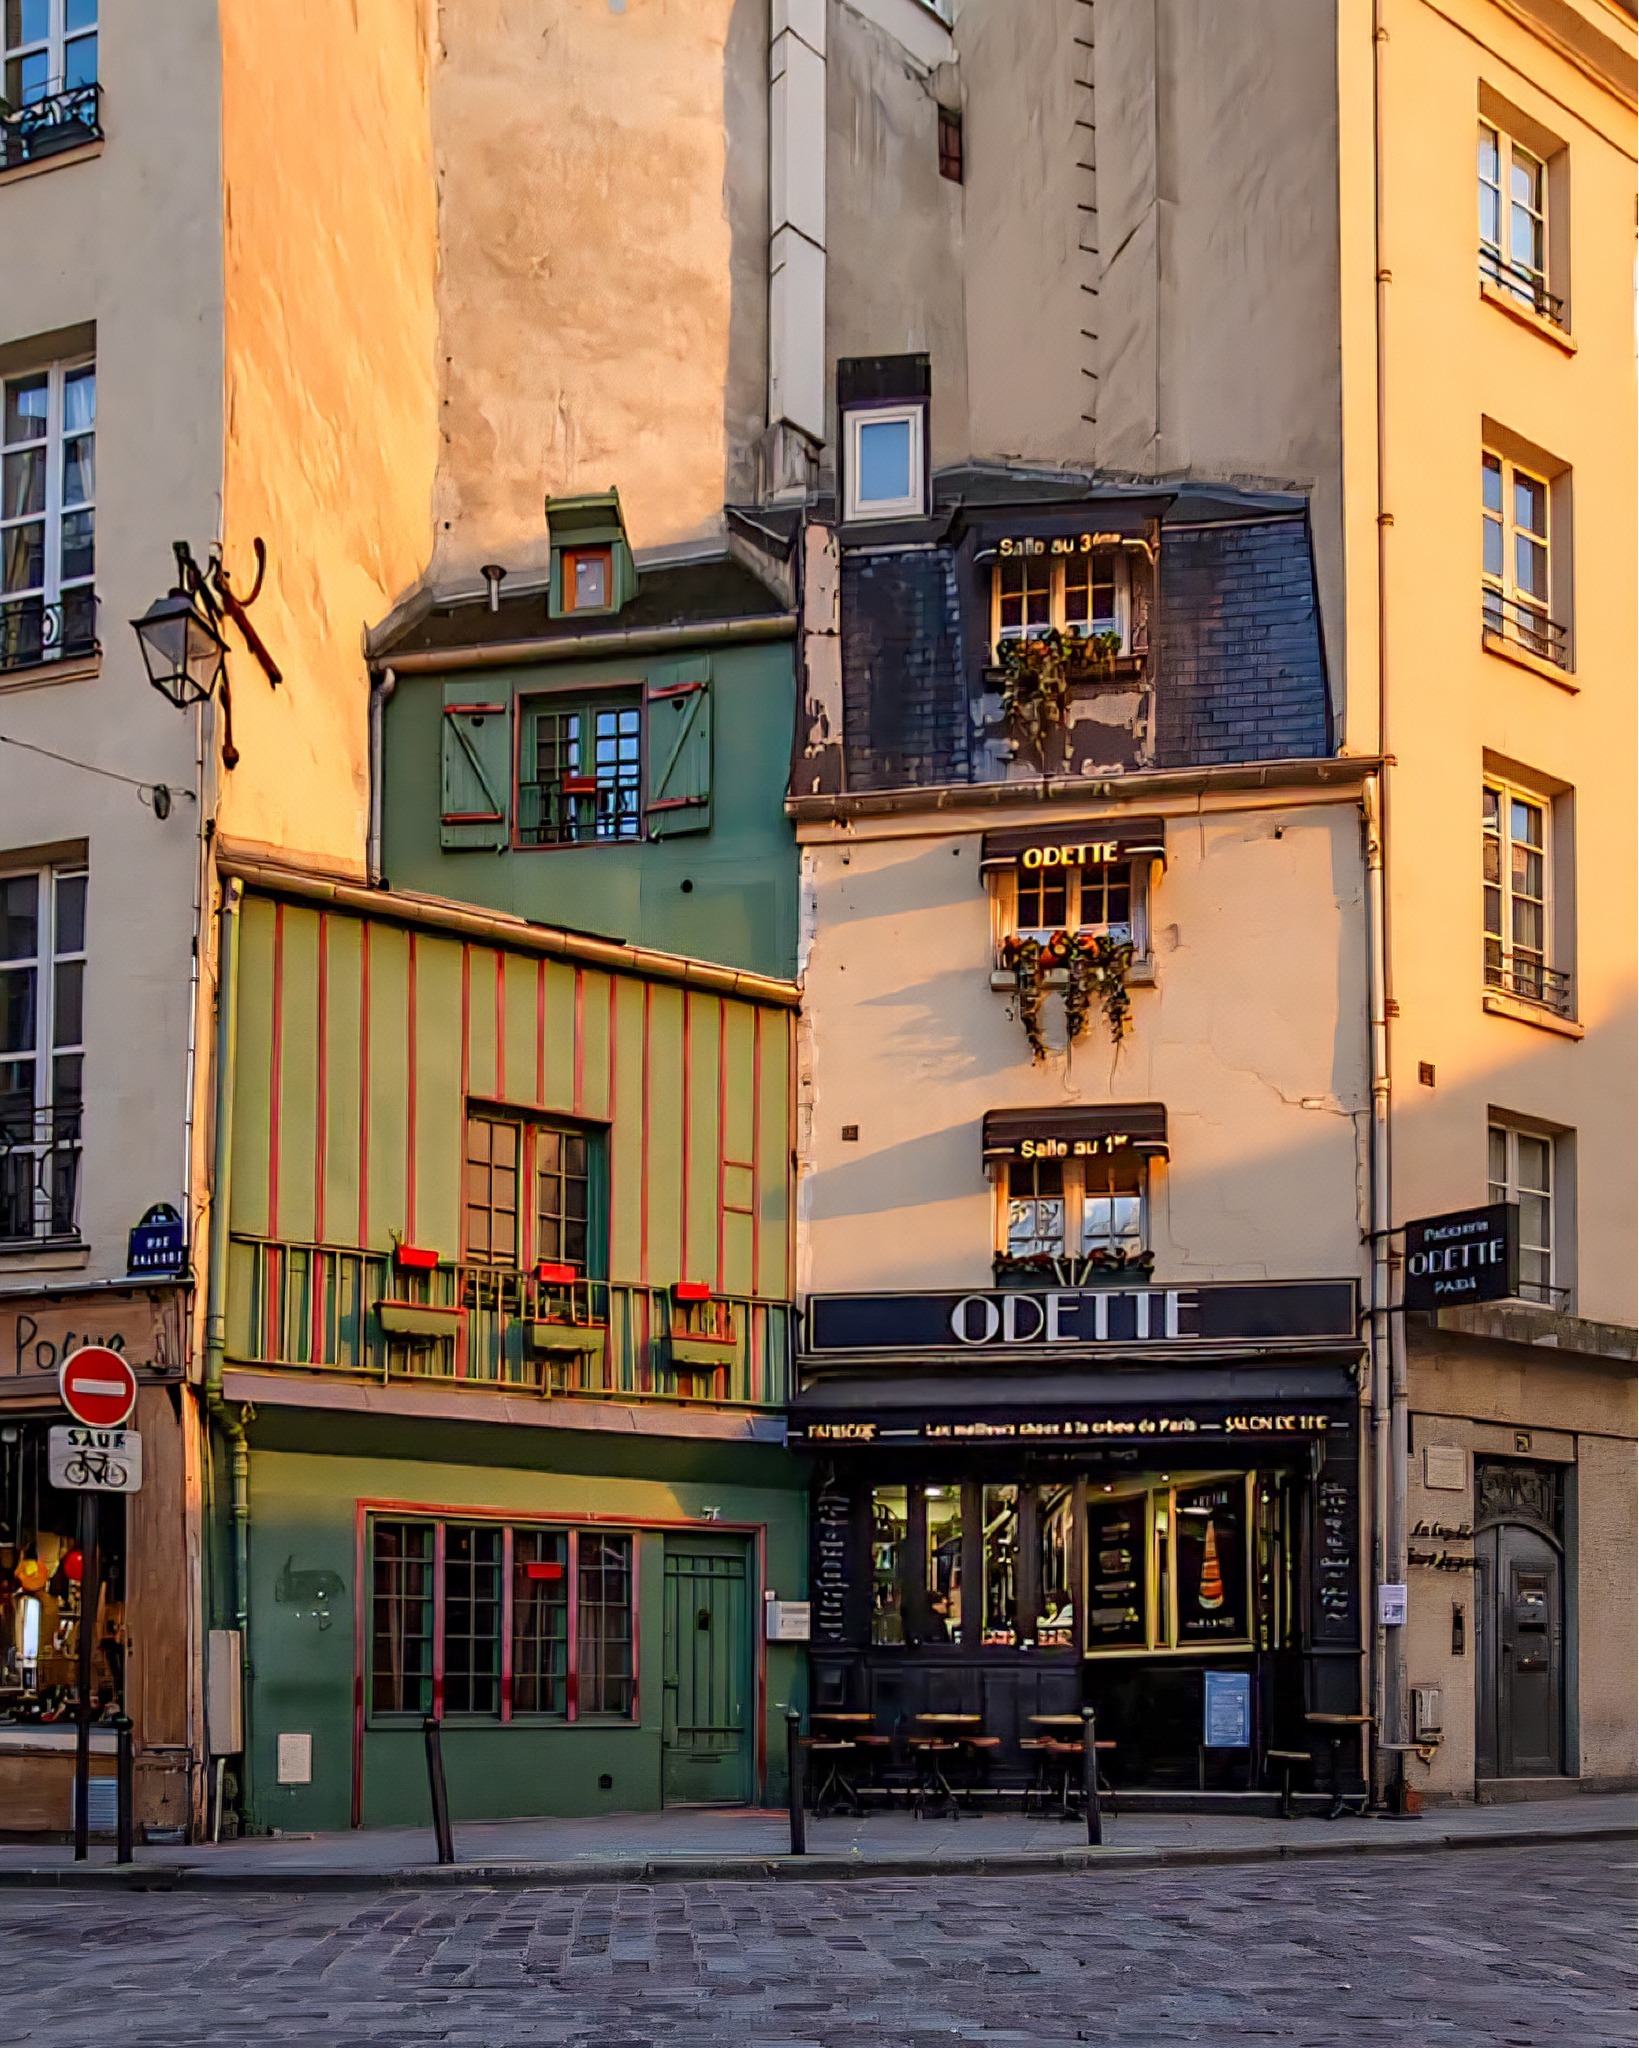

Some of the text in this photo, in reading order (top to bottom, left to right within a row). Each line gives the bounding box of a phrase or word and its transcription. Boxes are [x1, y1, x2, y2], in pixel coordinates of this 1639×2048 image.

[1051, 538, 1074, 554] au
[1022, 841, 1118, 869] ODETTE
[1021, 1138, 1068, 1158] Salle
[1073, 1140, 1099, 1155] au
[1408, 1238, 1504, 1276] ODETTE
[950, 1288, 1200, 1345] ODETTE
[68, 1429, 125, 1448] SAUF
